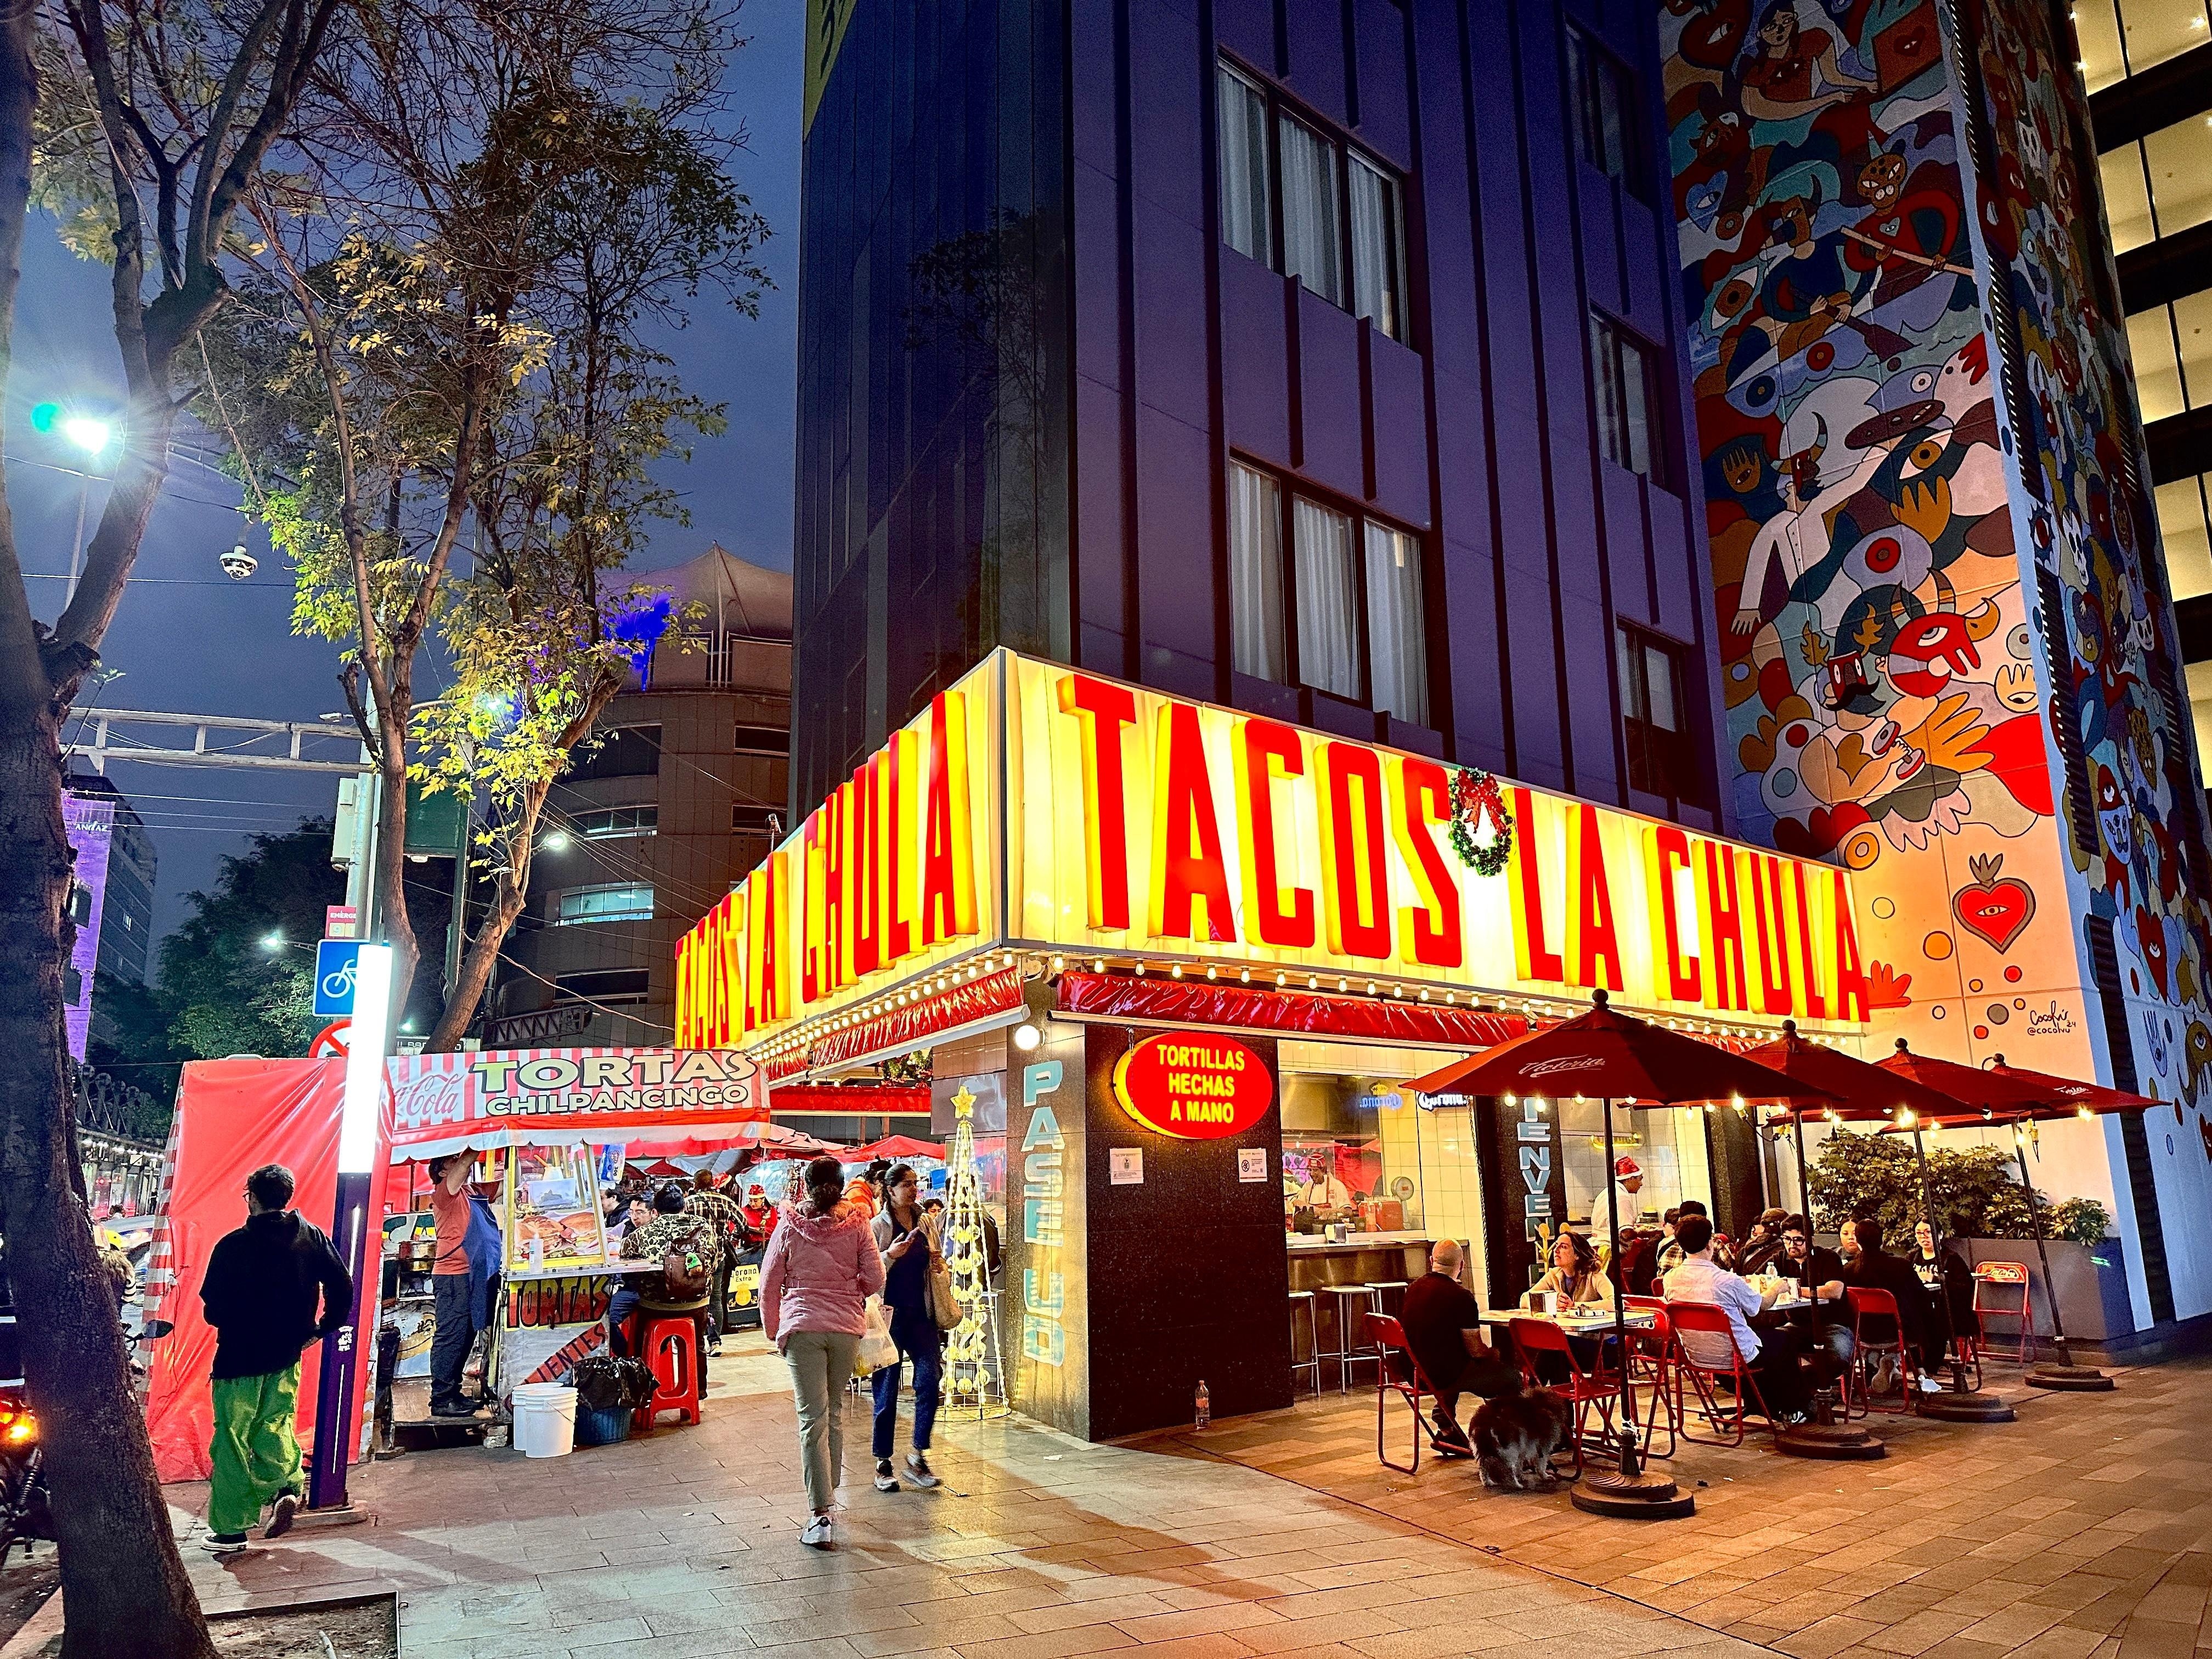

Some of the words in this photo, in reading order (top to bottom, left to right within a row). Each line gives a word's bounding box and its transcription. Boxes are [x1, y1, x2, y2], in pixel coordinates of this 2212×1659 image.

[744, 851, 789, 1031] LA
[802, 690, 971, 1004] CHULA
[1059, 673, 1462, 969] TACOS
[1506, 788, 1624, 992] LA
[1645, 826, 1870, 1023] CHULA
[468, 1051, 760, 1094] TORTAS
[1156, 1044, 1245, 1071] TORTILLAS
[486, 1084, 749, 1116] CHILPANCINGO
[1168, 1072, 1235, 1097] HECHAS
[1170, 1099, 1182, 1121] A
[1186, 1100, 1234, 1124] MANO
[1021, 1059, 1066, 1247] PASE
[731, 1268, 757, 1279] orona
[506, 1275, 611, 1330] TORTAS
[524, 1322, 606, 1383] IENTES
